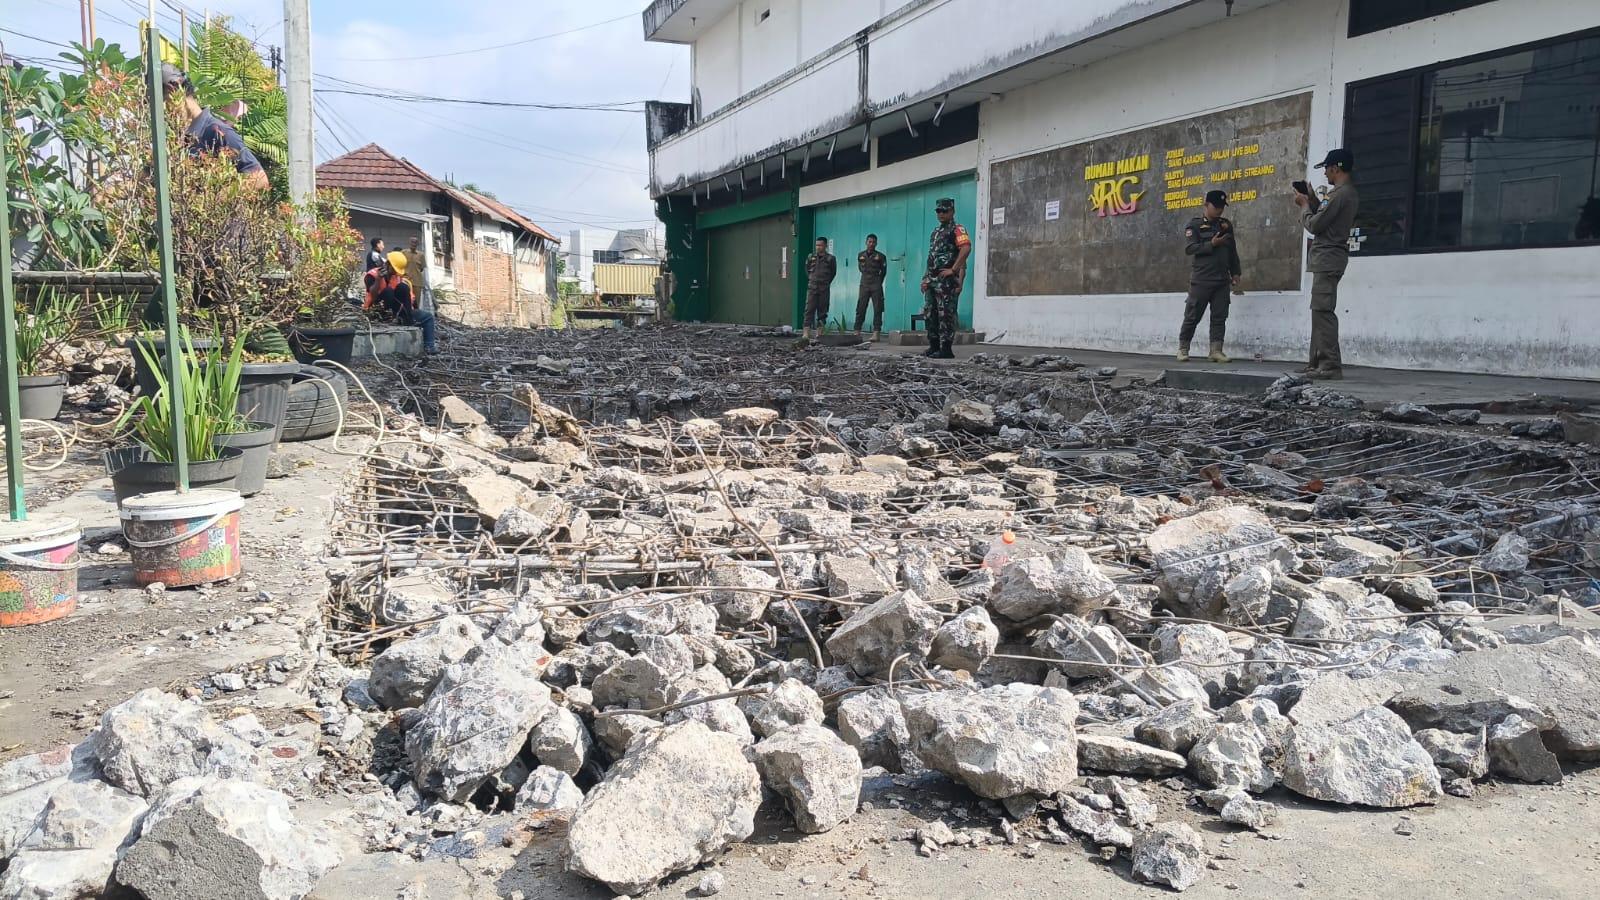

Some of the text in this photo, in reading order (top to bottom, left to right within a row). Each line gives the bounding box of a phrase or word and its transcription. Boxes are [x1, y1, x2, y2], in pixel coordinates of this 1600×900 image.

[1231, 146, 1244, 158] LIVE
[1244, 143, 1259, 155] BAND
[1084, 154, 1151, 180] RUMAH MAKAN
[1230, 169, 1242, 180] LIVE
[1244, 164, 1275, 177] STREAMING
[1229, 191, 1242, 202] LIVE
[1242, 189, 1257, 201] BAND
